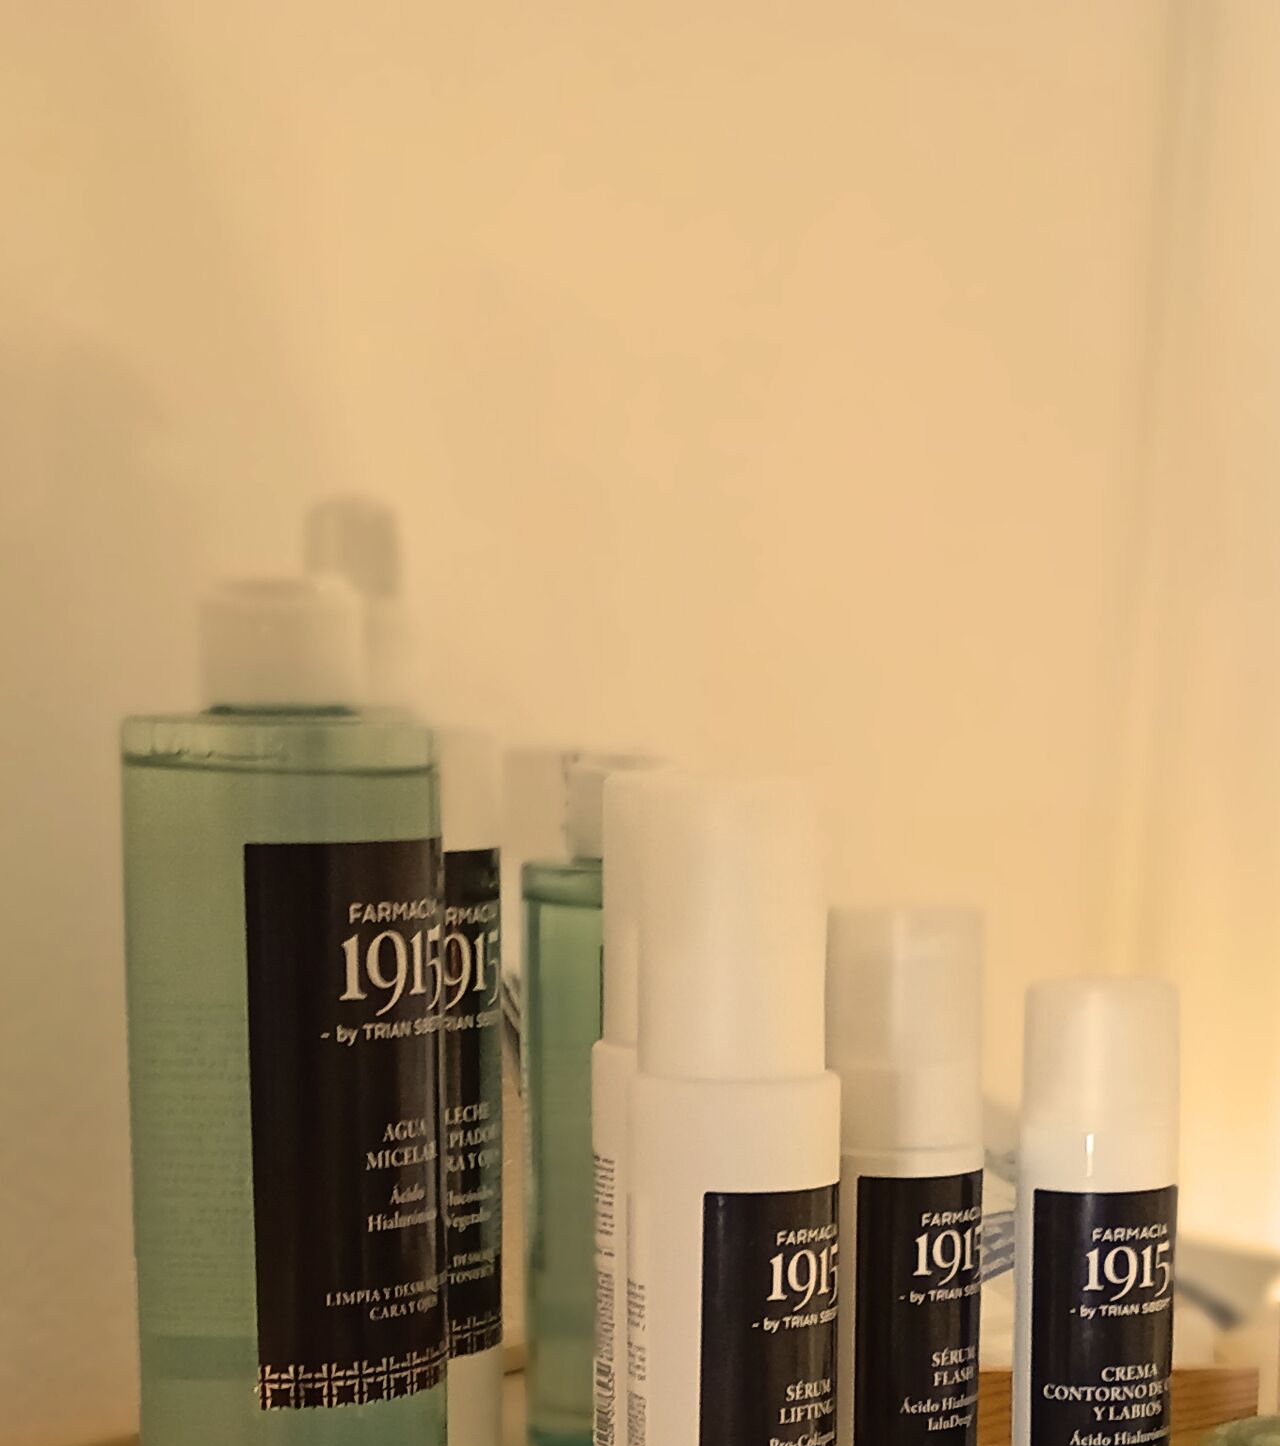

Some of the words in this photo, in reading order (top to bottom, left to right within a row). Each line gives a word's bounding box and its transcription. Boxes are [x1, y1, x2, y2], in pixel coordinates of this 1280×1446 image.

[339, 925, 442, 1016] 1915
[443, 929, 500, 1010] 915
[336, 1024, 359, 1046] by
[362, 1020, 413, 1040] TRIAN
[383, 1119, 427, 1142] AGUA
[766, 1243, 839, 1312] 1915
[1082, 1240, 1170, 1302] 1915
[325, 1289, 381, 1307] LIMPIA
[383, 1287, 392, 1300] Y
[909, 1290, 926, 1306] by
[369, 1302, 407, 1320] CARA
[1080, 1304, 1096, 1320] by
[1098, 1303, 1140, 1317] TRIAN
[763, 1316, 780, 1334] by
[782, 1313, 818, 1329] TRIAN
[1101, 1363, 1159, 1383] CREMA
[786, 1378, 832, 1401] SÉRUM
[1043, 1382, 1147, 1402] CONTORNO
[1148, 1380, 1163, 1398] DE
[899, 1395, 939, 1414] Ácido
[1093, 1405, 1106, 1422] Y
[1108, 1399, 1162, 1421] LABIOS
[1070, 1428, 1111, 1446] Ácido
